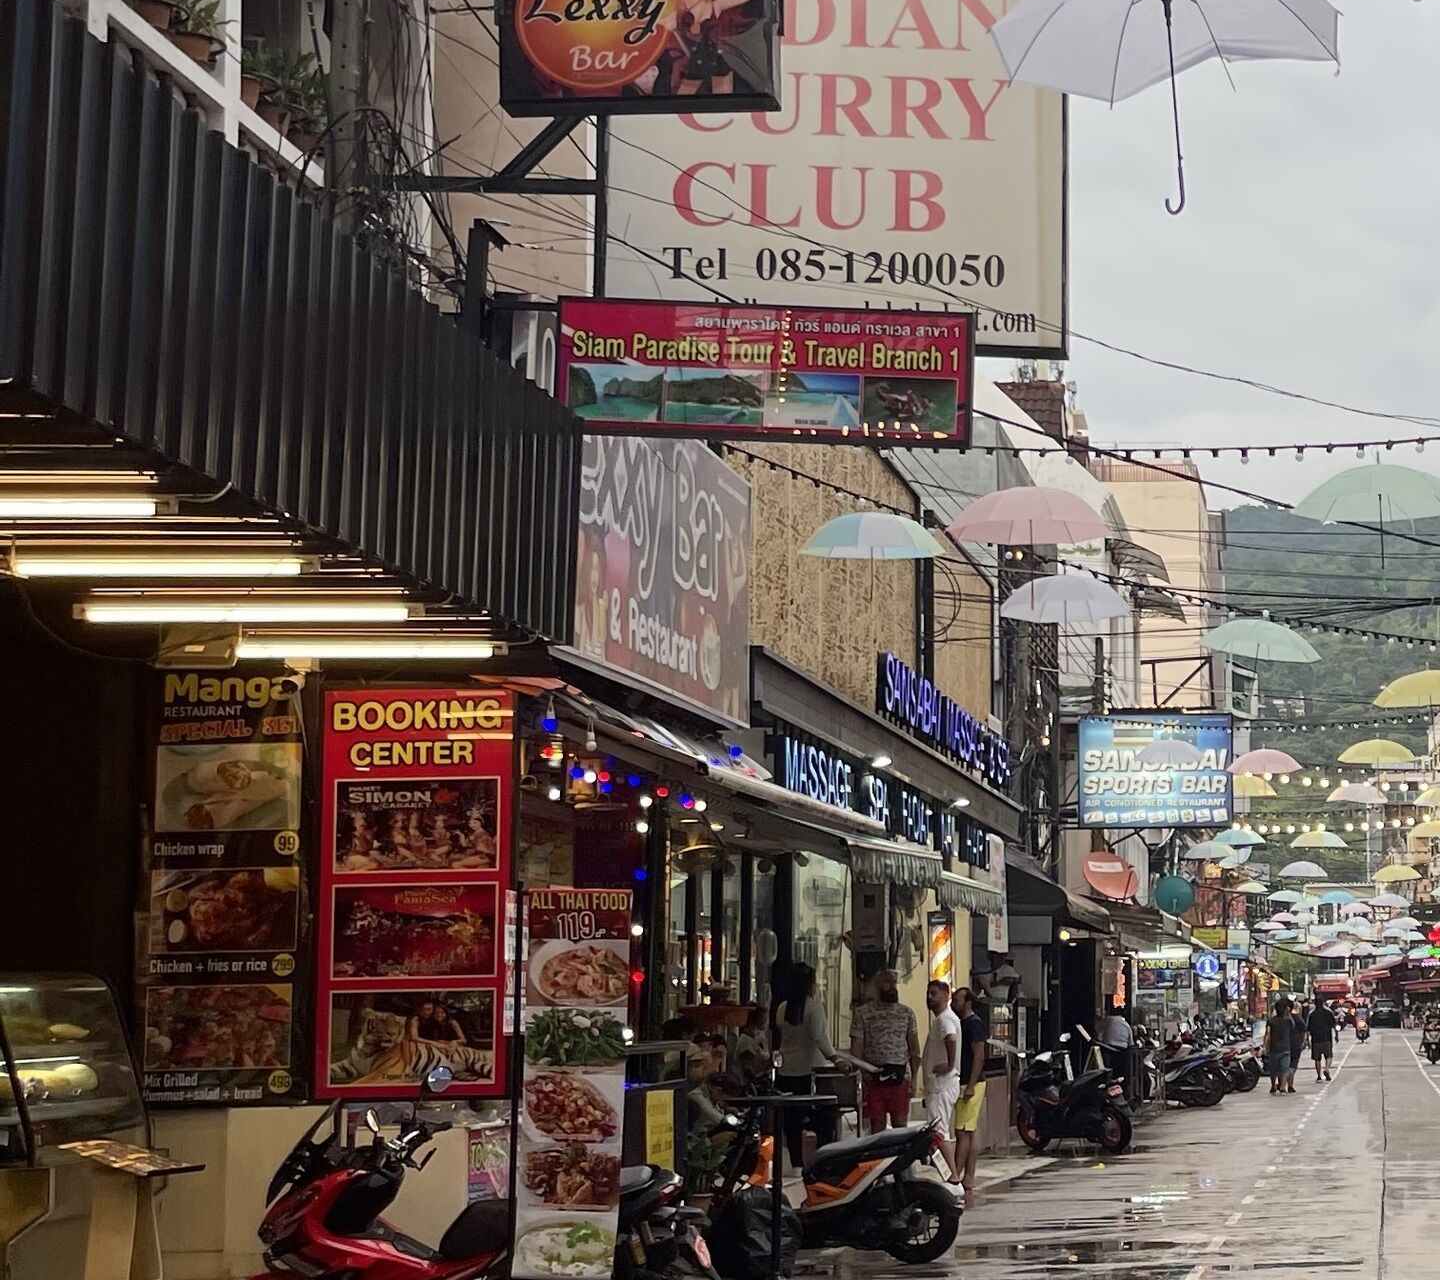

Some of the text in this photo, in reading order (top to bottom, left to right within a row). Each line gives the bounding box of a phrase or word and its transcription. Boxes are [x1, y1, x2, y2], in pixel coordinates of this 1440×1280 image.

[569, 45, 639, 71] Bar
[676, 71, 1009, 141] URRY
[673, 161, 947, 232] CLUB
[662, 247, 1006, 287] Tel 085-1200050
[572, 331, 627, 360] Siam
[631, 333, 720, 364] Paradise
[725, 341, 774, 365] Tour
[805, 340, 865, 369] Travel
[872, 343, 943, 372] Branch
[949, 347, 960, 372] 1
[671, 442, 725, 602] Bar
[628, 596, 698, 681] Restaurant
[163, 705, 243, 718] RESTAURANT
[332, 699, 502, 732] BOOKING
[159, 719, 253, 743] SPECIAL
[349, 740, 473, 767] CENTER
[1082, 748, 1228, 772] SANAI
[1083, 774, 1228, 795] SPORTS BAR
[348, 790, 432, 804] SIMON
[153, 842, 225, 857] Chicken wrap
[277, 835, 296, 852] 99
[530, 892, 628, 910] ALL THAI FOOD
[150, 959, 193, 974] Chicken
[207, 958, 229, 972] fries
[231, 960, 243, 972] or
[246, 958, 268, 972] rice
[163, 1072, 199, 1088] Grilled
[233, 1085, 263, 1100] bread
